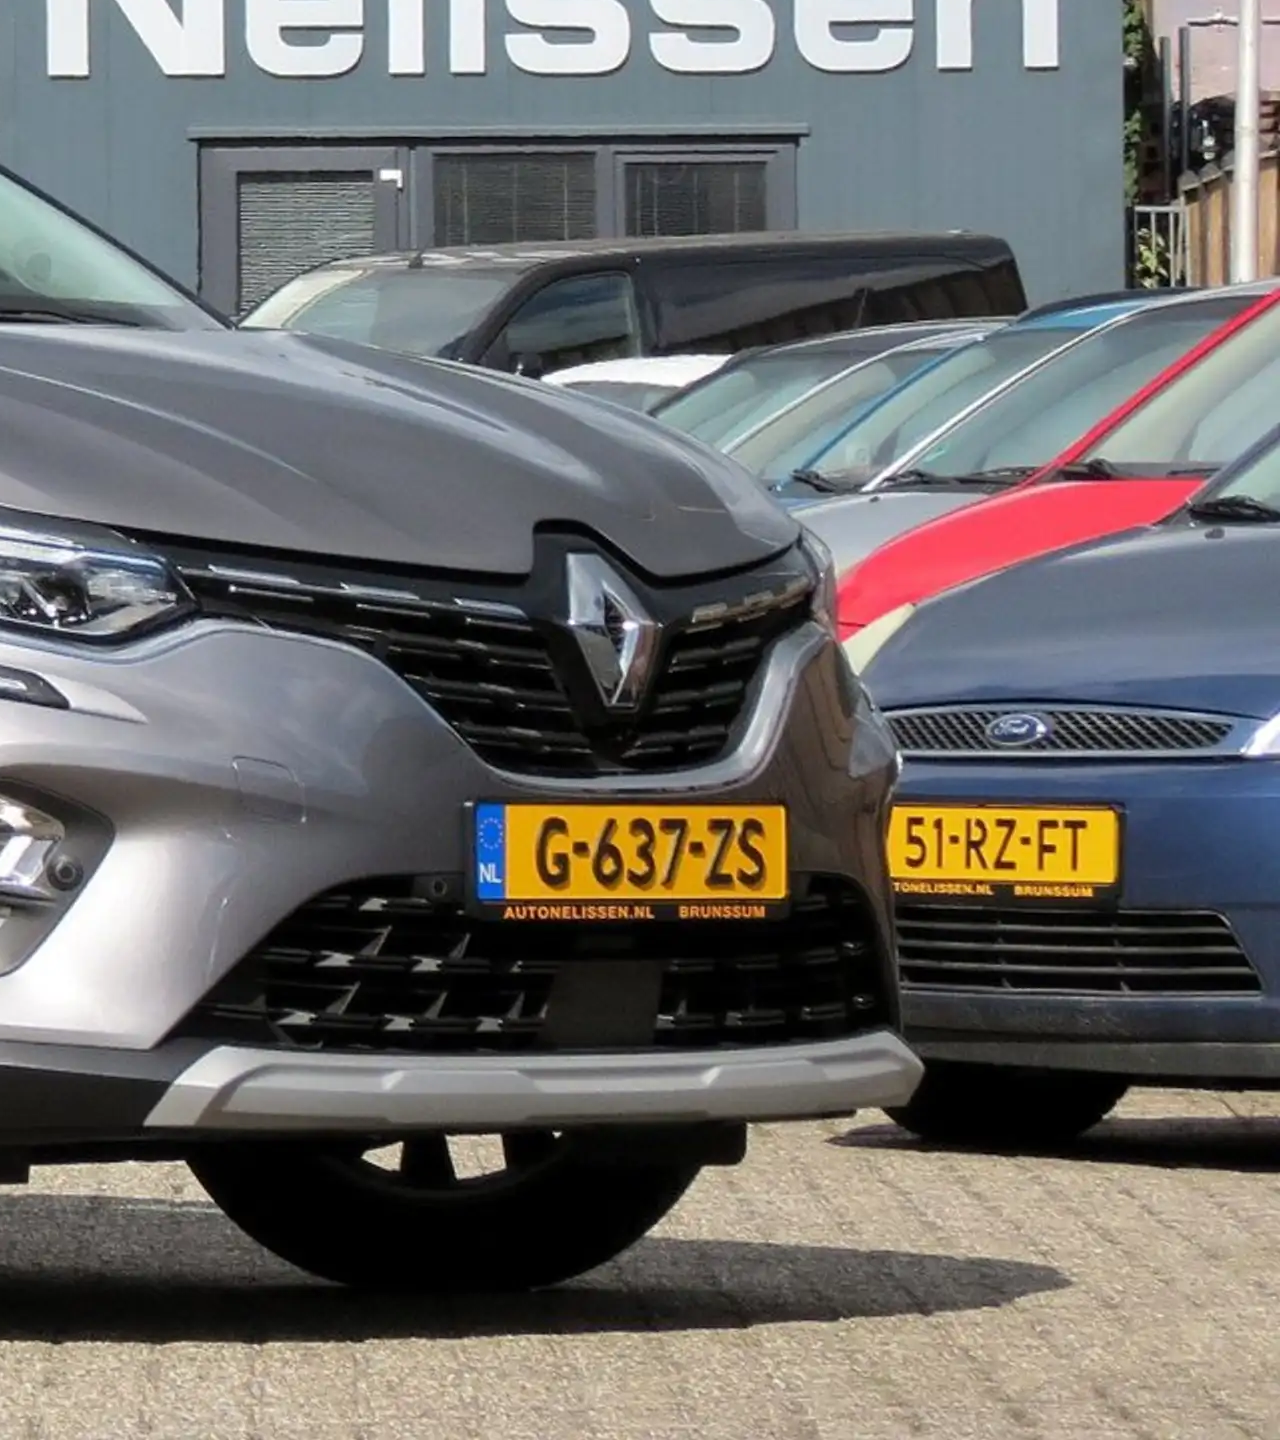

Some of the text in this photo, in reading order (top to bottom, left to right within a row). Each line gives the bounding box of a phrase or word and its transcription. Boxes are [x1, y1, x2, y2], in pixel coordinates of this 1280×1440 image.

[536, 817, 766, 891] G-637-ZS
[905, 816, 1088, 872] 51-RZ-FT
[479, 863, 502, 884] NL
[892, 881, 1094, 898] TONELISSEN.NL BRUNSSUM
[503, 905, 766, 920] AUTONELISSEN.NL BRUNSSUM
